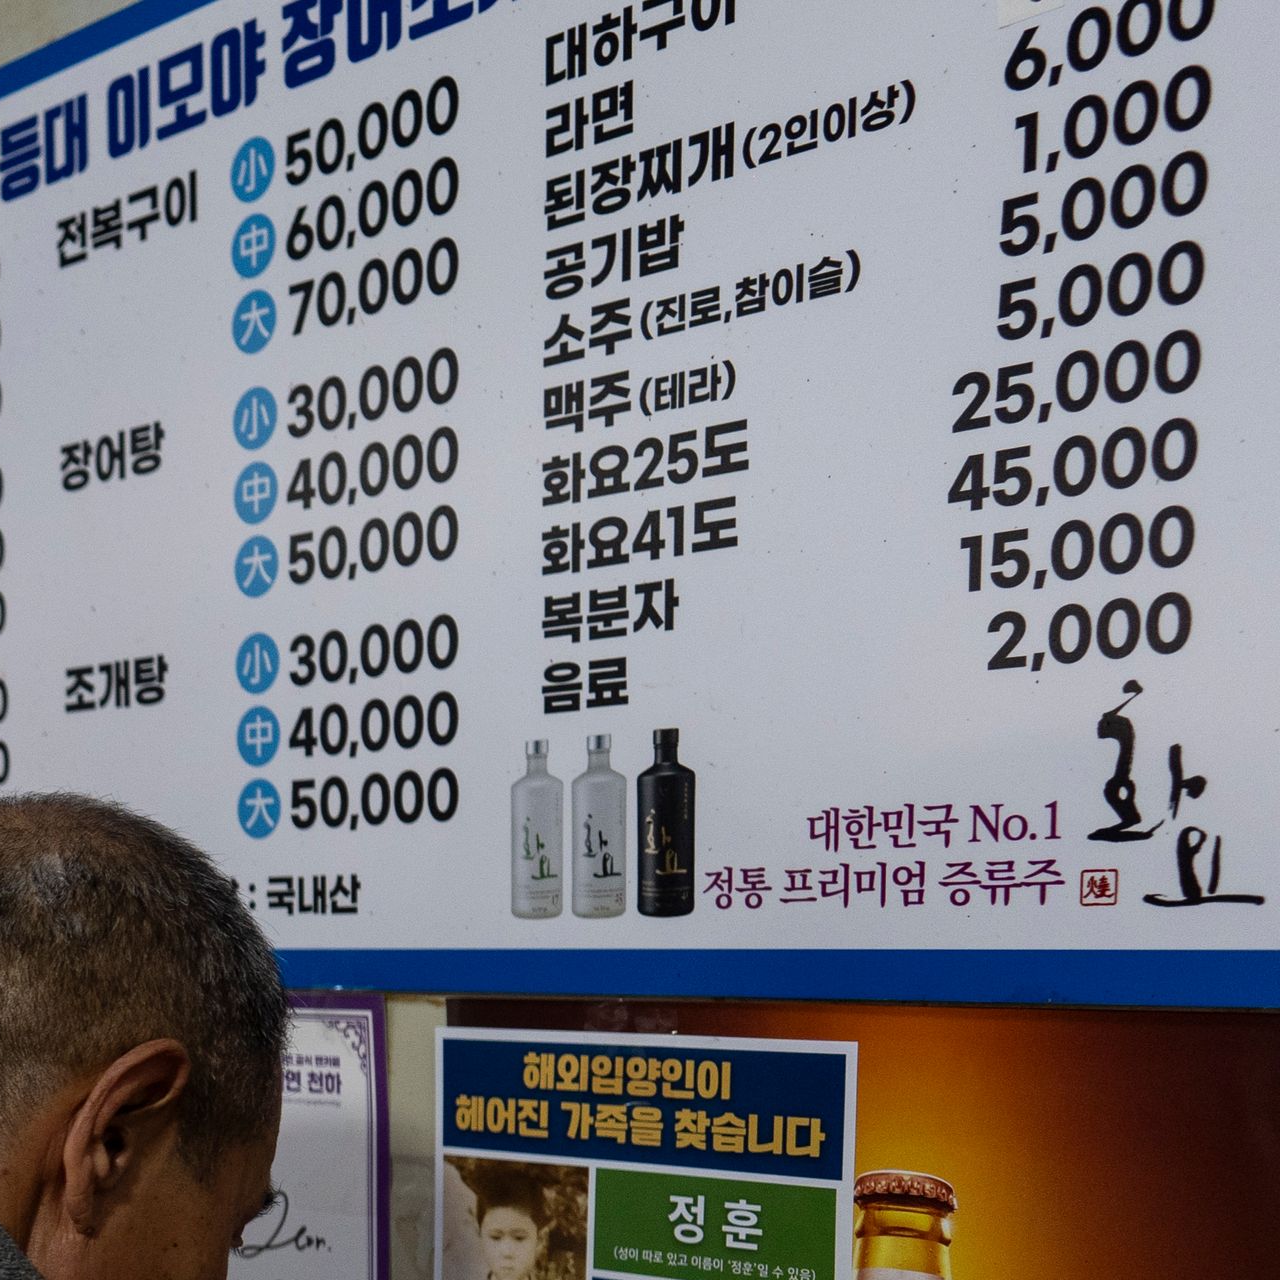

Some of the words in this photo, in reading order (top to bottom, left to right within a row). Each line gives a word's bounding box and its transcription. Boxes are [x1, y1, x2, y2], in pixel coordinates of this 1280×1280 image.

[1004, 0, 1215, 91] 6,000
[0, 92, 88, 202] 등대
[107, 17, 266, 159] 이모야
[281, 0, 506, 88] 장어
[236, 145, 269, 195] 小
[285, 76, 459, 186] 50,000
[546, 80, 633, 157] 라면
[1015, 65, 1211, 173] 1,000
[545, 121, 734, 230] 된장찌개
[743, 79, 915, 168] (2인이상)
[58, 170, 198, 267] 전복구이
[239, 221, 271, 271] 中
[285, 157, 459, 260] 60,000
[1000, 151, 1208, 256] 5,000
[239, 299, 271, 348] 大
[288, 237, 459, 335] 70,000
[544, 213, 684, 300] 공기밥
[997, 240, 1204, 340] 5,000
[543, 298, 632, 367] 소주
[640, 249, 860, 340] (진로,참이슬)
[238, 393, 271, 443] 小
[287, 347, 459, 437] 30,000
[544, 370, 631, 432] 맥주
[640, 360, 736, 415] (테라)
[952, 329, 1201, 433] 25,000
[61, 421, 165, 492] 장어탕
[241, 469, 271, 517] 中
[287, 426, 459, 508] 40,000
[542, 418, 749, 507] 화요25도
[948, 418, 1198, 511] 45,000
[241, 543, 274, 591] 大
[287, 505, 458, 584] 50,000
[542, 496, 738, 575] 화요41도
[961, 505, 1195, 592] 15,000
[241, 640, 273, 687] 小
[289, 614, 458, 686] 30,000
[542, 578, 679, 643] 복분자
[987, 592, 1192, 672] 2,000
[65, 655, 168, 713] 조개탕
[243, 712, 275, 760] 中
[289, 691, 458, 757] 40,000
[542, 657, 628, 714] 음료
[244, 784, 276, 832] 大
[290, 767, 458, 830] 50,000
[807, 804, 959, 852] 대한민국
[968, 801, 1062, 843] No.1
[1087, 680, 1265, 907] 화요
[267, 874, 361, 915] 국내산
[703, 867, 771, 909] 정통
[779, 862, 926, 908] 프리미엄
[939, 858, 1064, 906] 증류주
[307, 1071, 342, 1094] 천하
[523, 1051, 732, 1100] 해외입양인이
[455, 1094, 549, 1138] 헤어진
[561, 1103, 664, 1147] 가족을
[675, 1109, 825, 1158] 찾습니다
[613, 1246, 640, 1261] (성이
[642, 1249, 663, 1264] 따로
[667, 1252, 687, 1267] 있고
[691, 1255, 723, 1272] 이름이
[668, 1195, 706, 1244] 정
[722, 1199, 764, 1251] 훈
